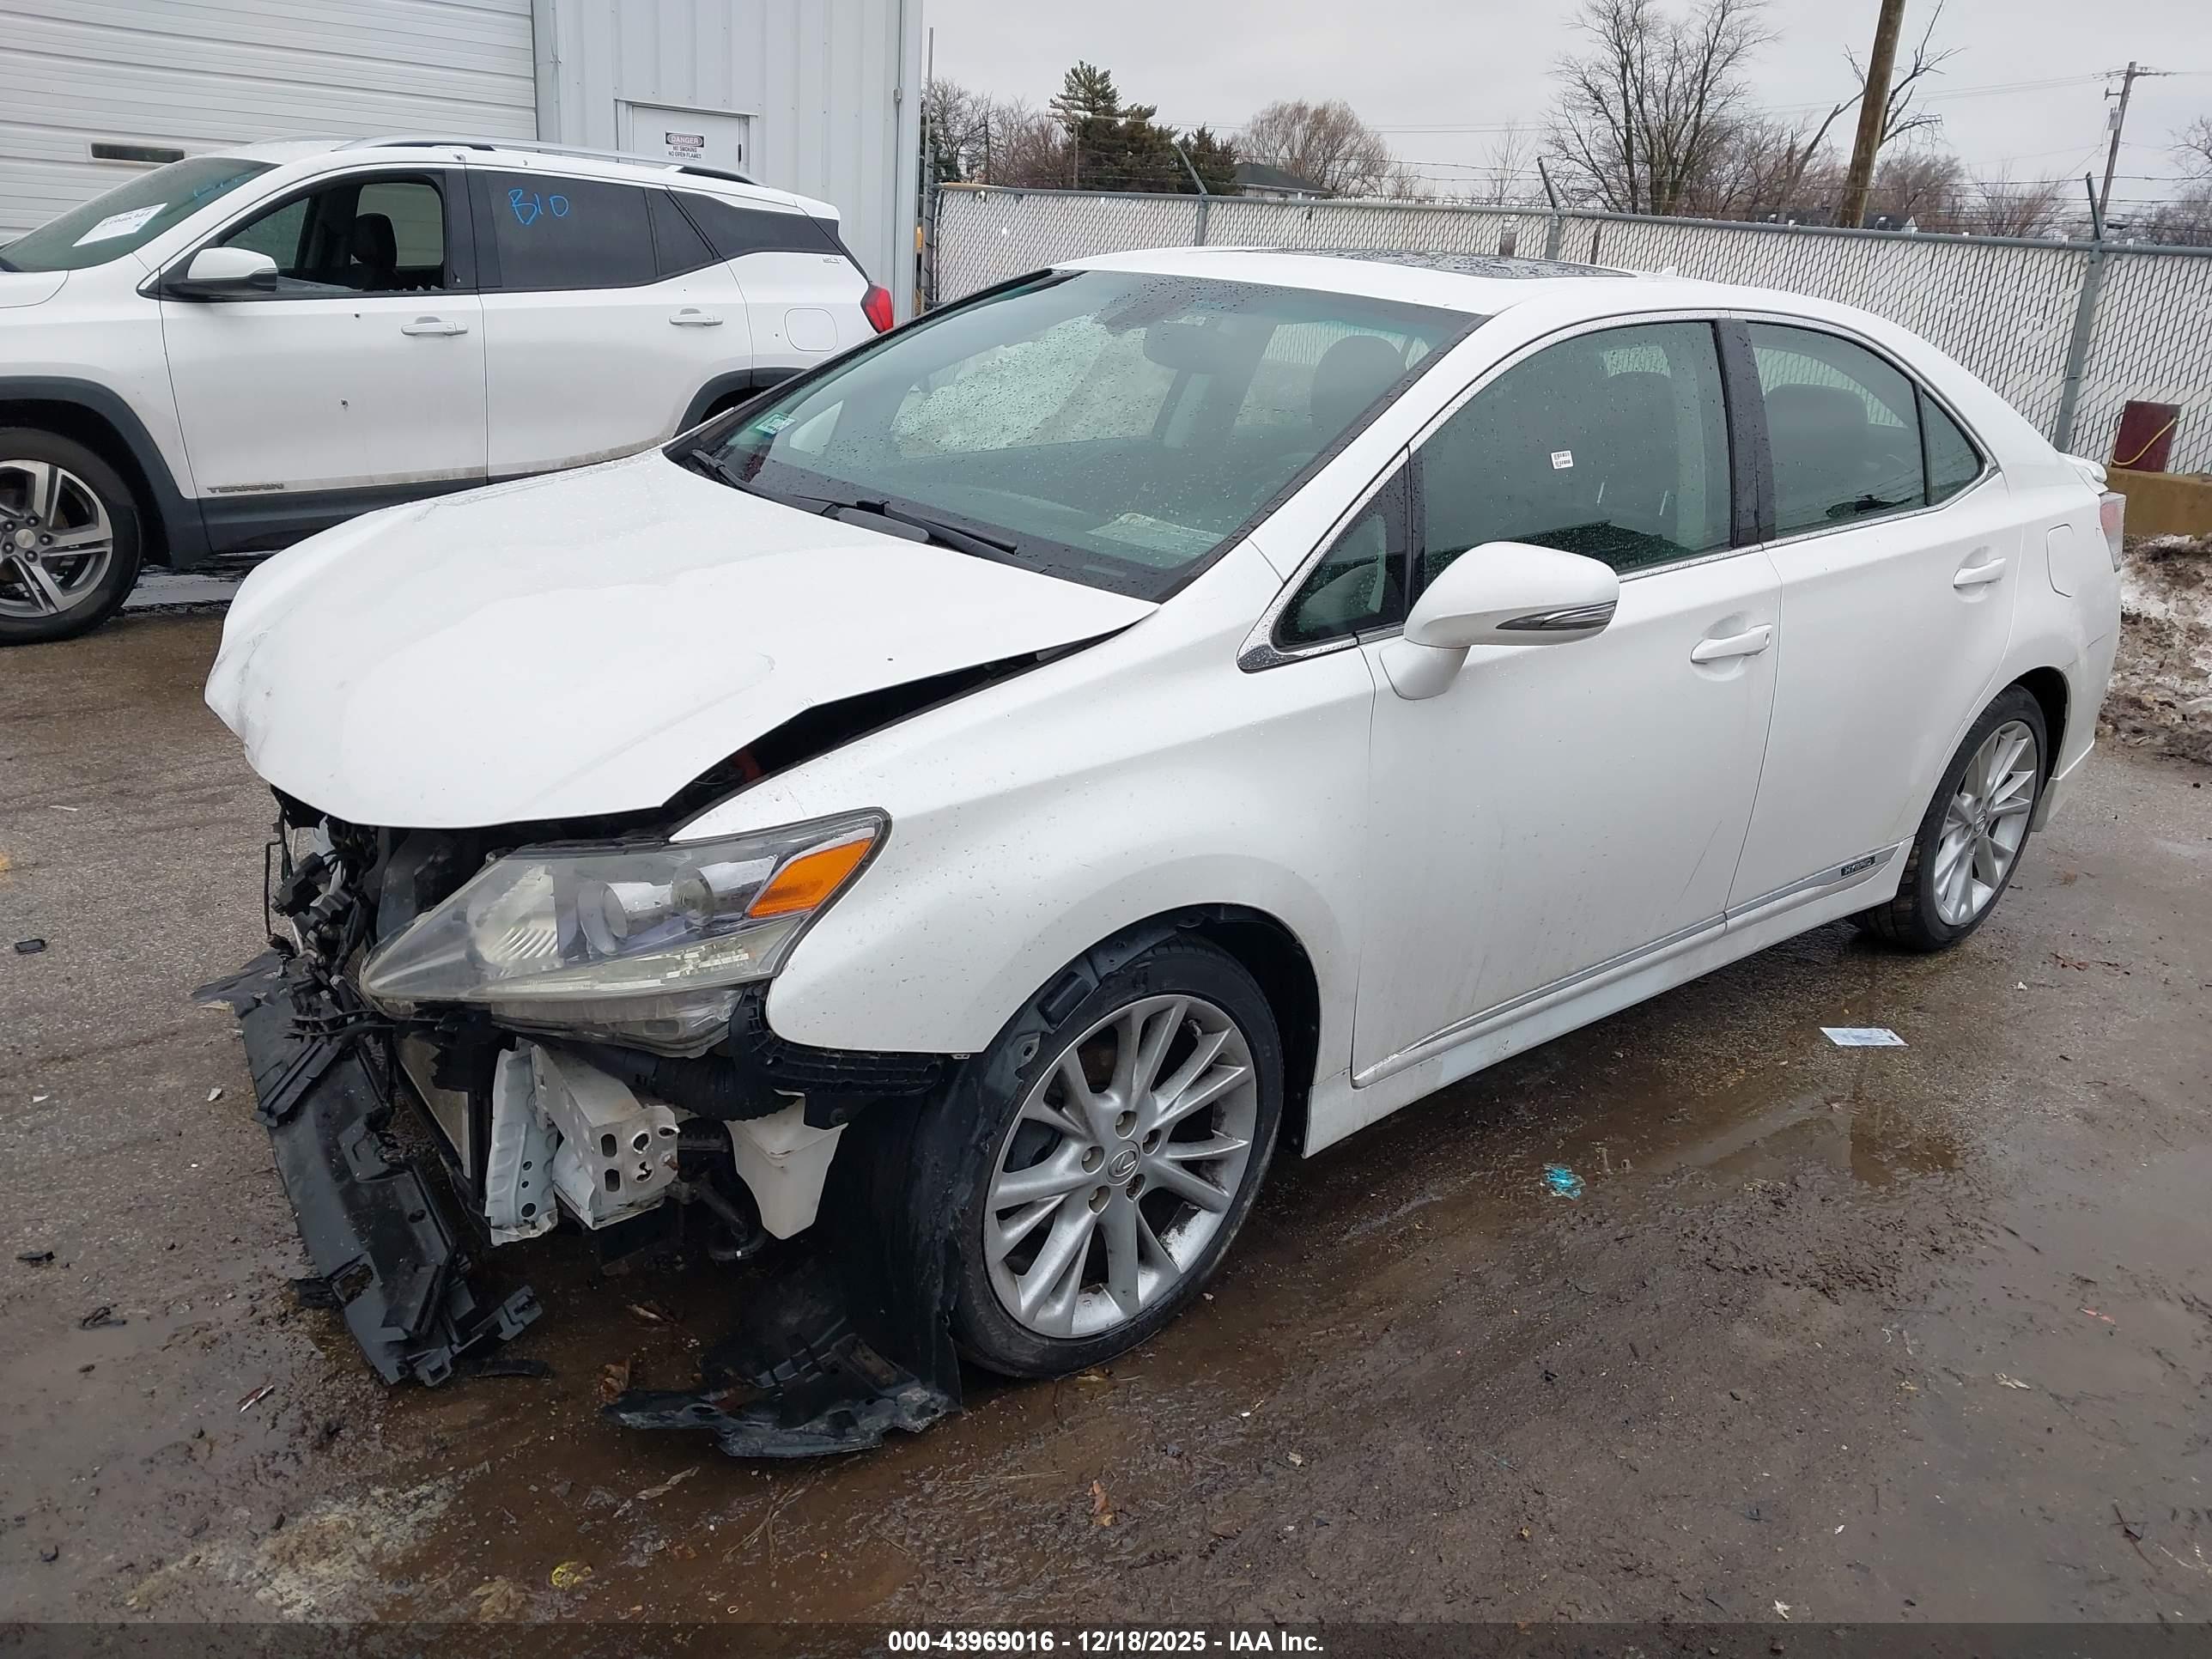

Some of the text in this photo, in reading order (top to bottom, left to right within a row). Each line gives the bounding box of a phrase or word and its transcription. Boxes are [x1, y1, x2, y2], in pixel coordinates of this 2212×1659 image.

[672, 136, 699, 145] DANGER
[207, 483, 284, 494] TERRAIN
[1844, 860, 1872, 874] HYBRID
